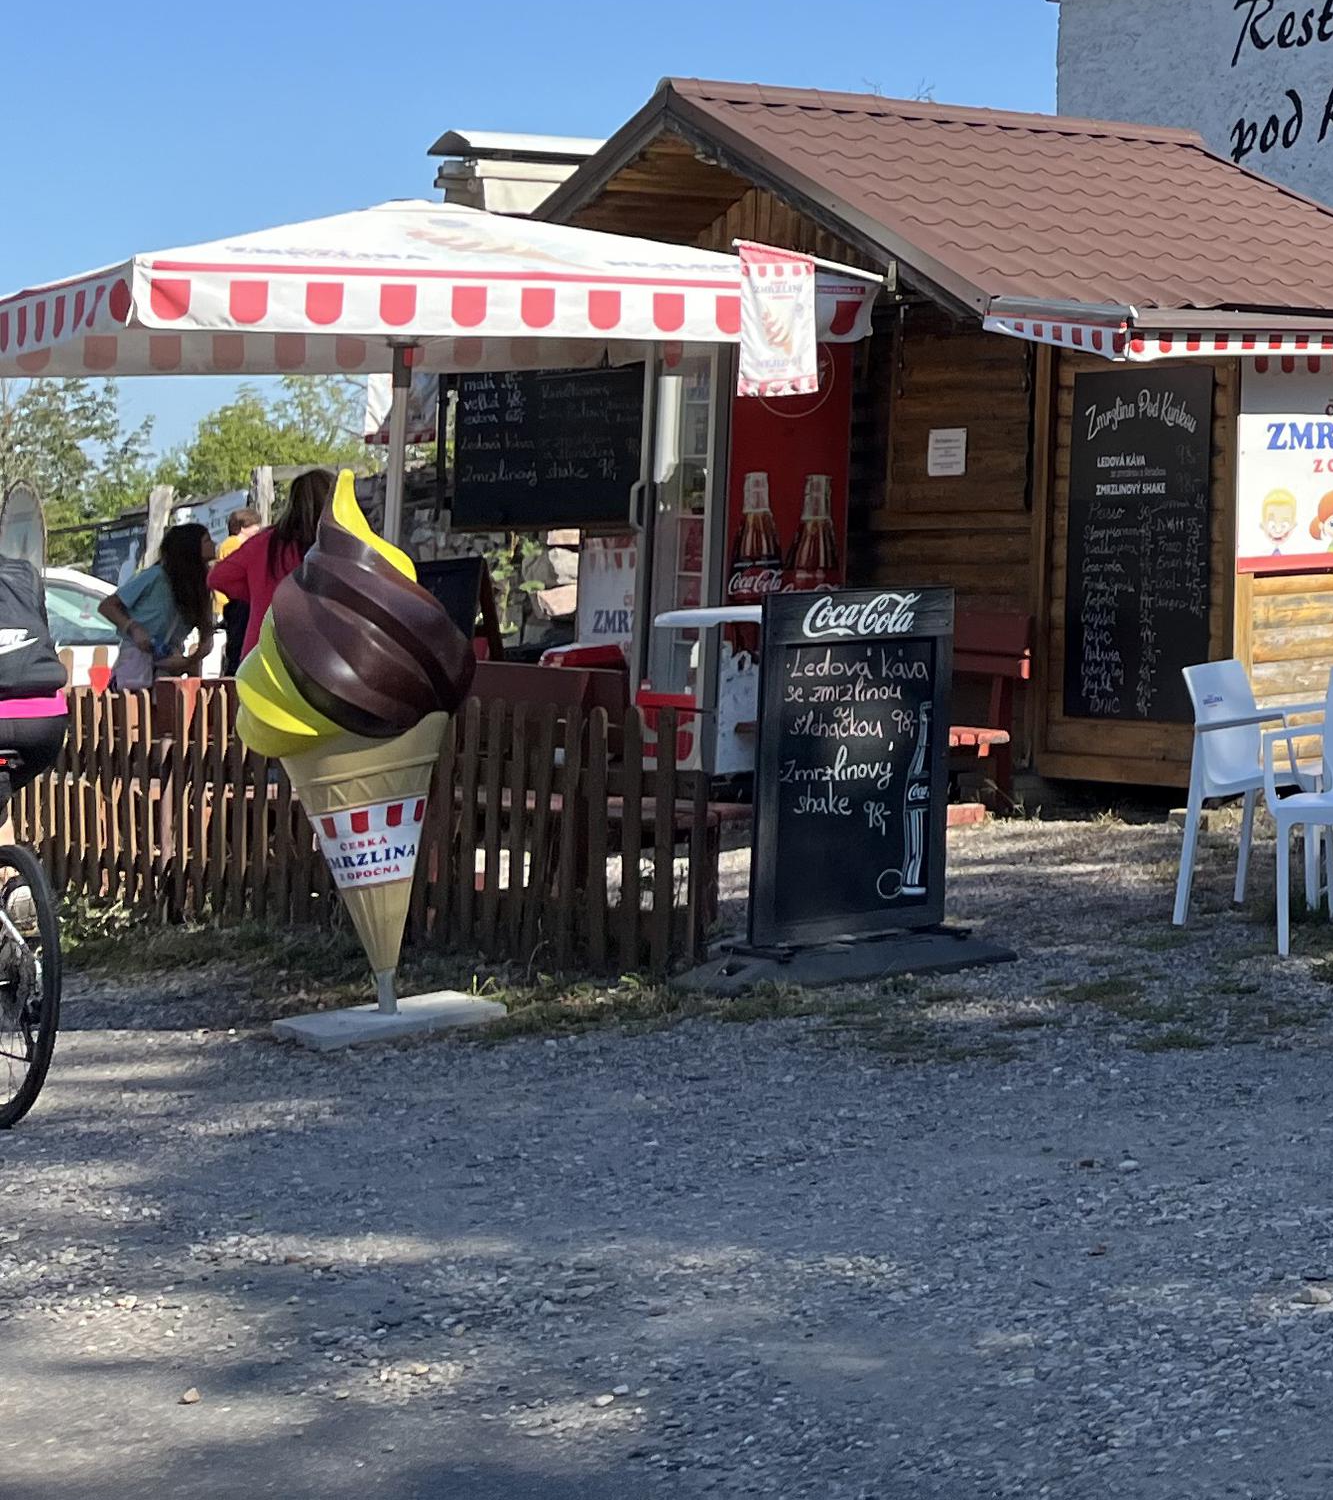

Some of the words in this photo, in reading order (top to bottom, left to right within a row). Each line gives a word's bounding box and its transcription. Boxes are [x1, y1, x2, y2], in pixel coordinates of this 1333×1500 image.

[1230, 90, 1303, 162] pod
[1313, 457, 1324, 473] Z
[728, 568, 783, 595] Coca-Cola
[802, 592, 922, 638] Coca-Cola
[791, 647, 873, 679] Ledová
[784, 684, 804, 703] se
[809, 676, 903, 702] zmrzlinou
[793, 781, 852, 815] shake
[328, 844, 416, 869] MRZLINA
